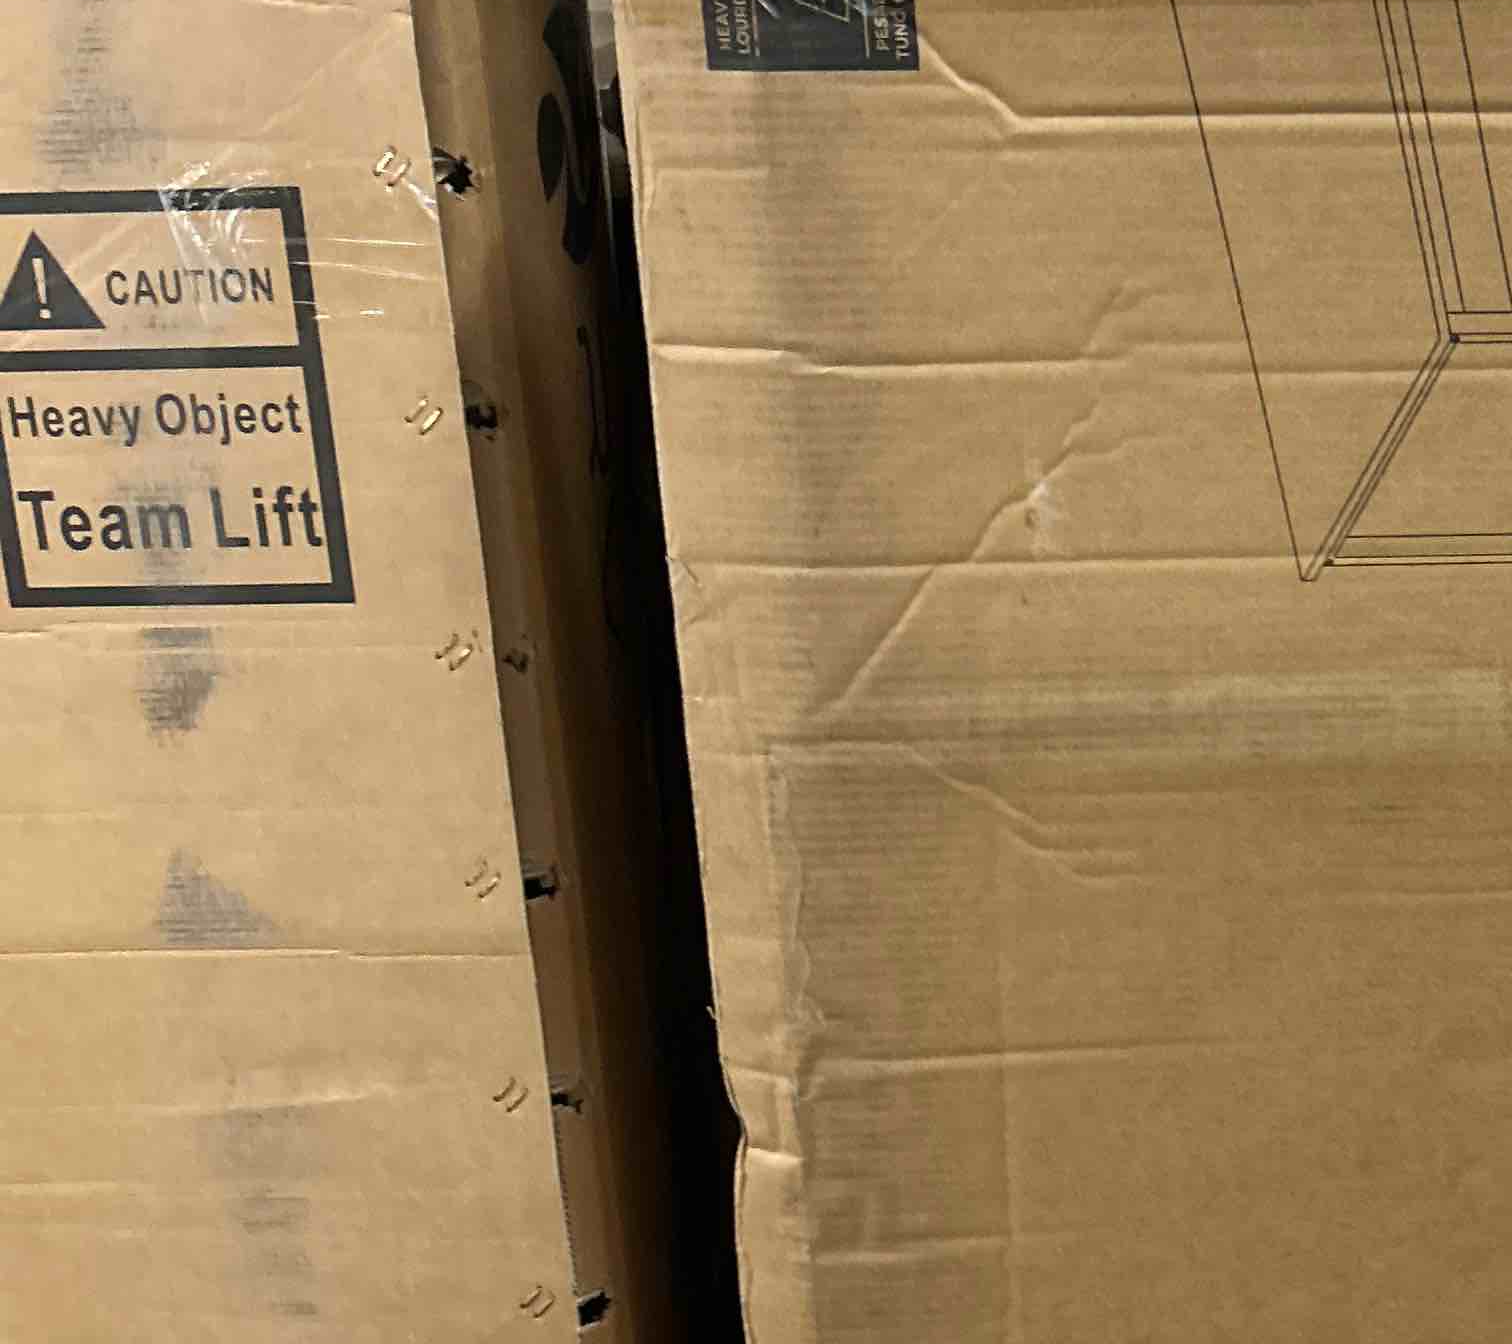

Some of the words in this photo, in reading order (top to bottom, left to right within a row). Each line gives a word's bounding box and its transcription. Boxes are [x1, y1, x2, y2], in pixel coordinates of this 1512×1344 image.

[104, 266, 276, 308] CAUTION
[7, 395, 142, 447] Heavy
[154, 392, 305, 446] Object
[17, 489, 193, 551] Team
[208, 485, 324, 549] Lift
